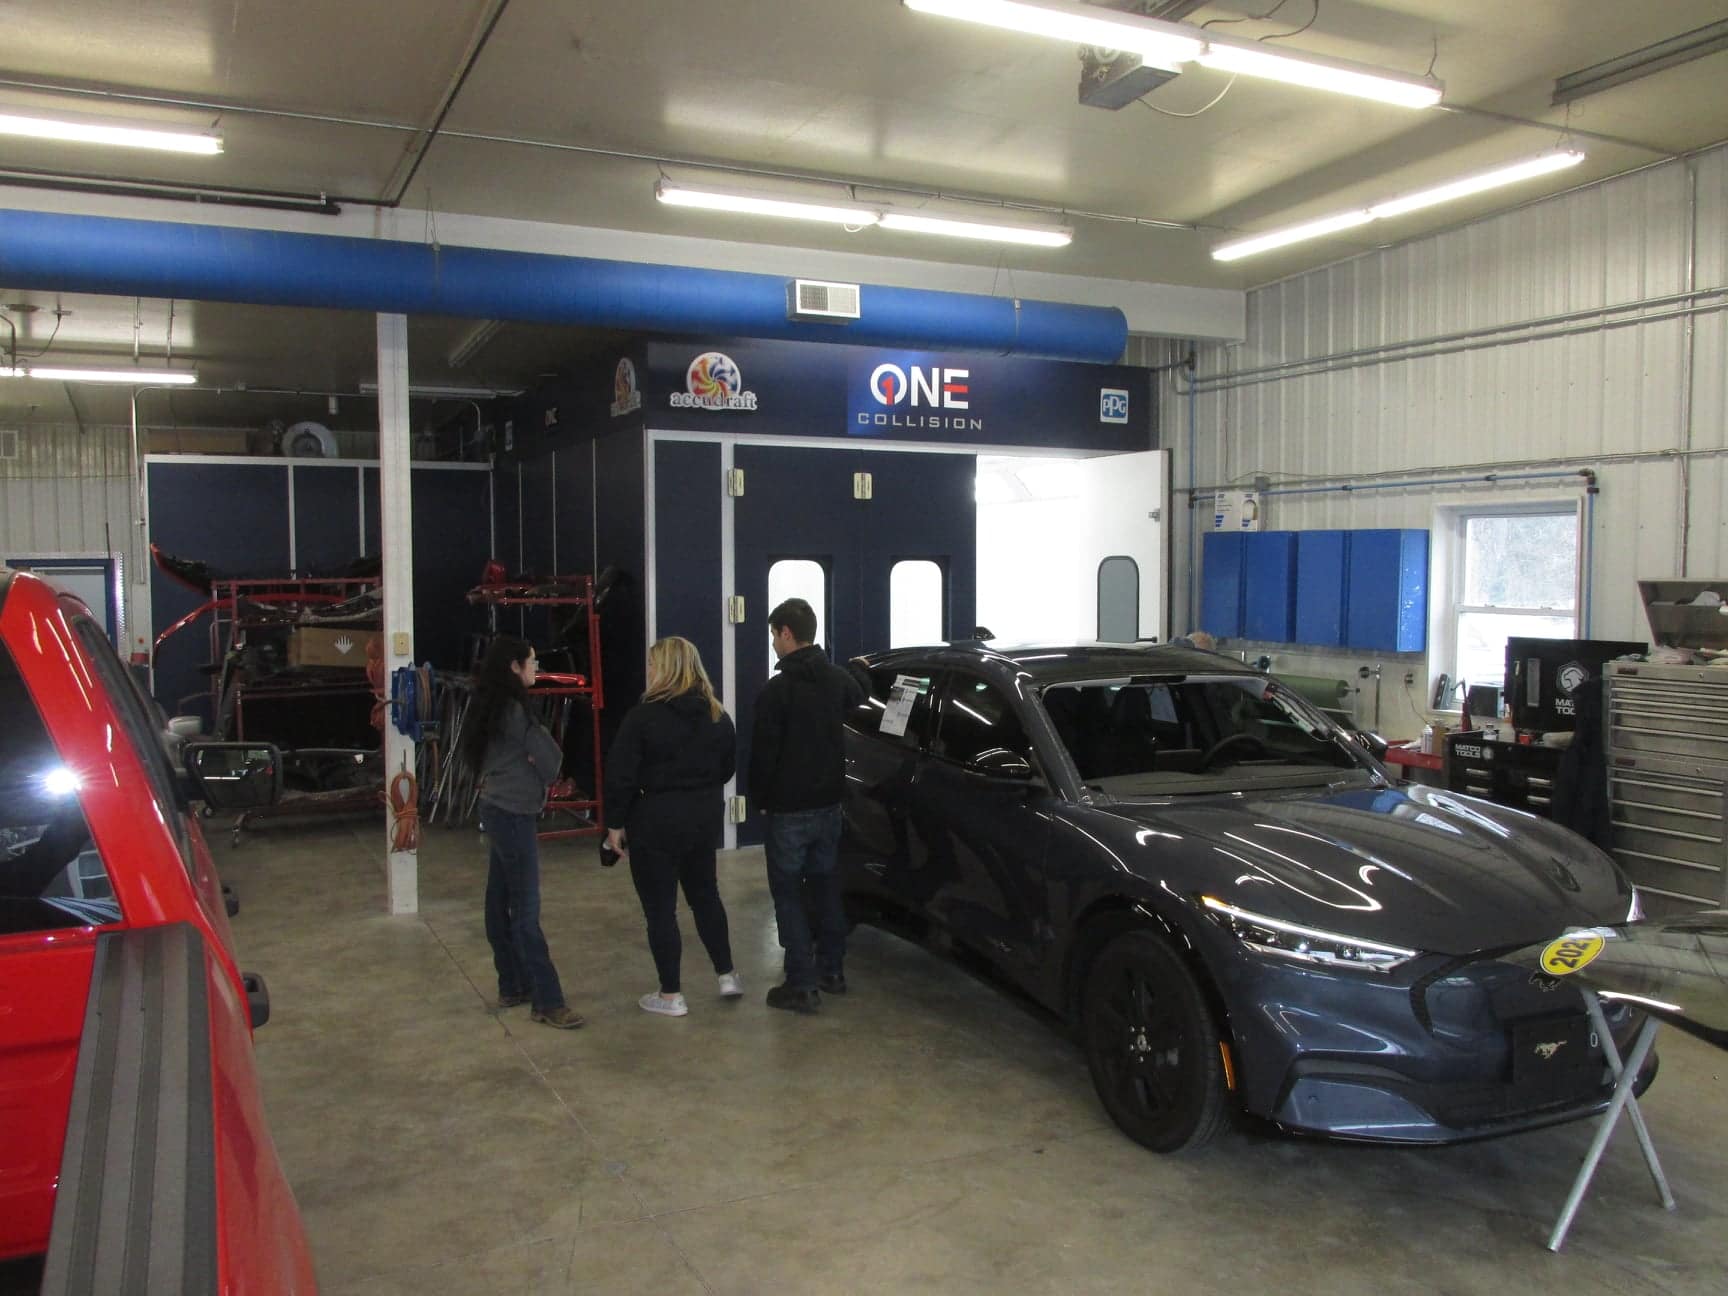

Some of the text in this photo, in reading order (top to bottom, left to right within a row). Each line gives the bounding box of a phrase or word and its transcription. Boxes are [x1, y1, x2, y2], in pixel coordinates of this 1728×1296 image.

[1103, 395, 1127, 416] PPG
[858, 413, 983, 430] COLLISION
[1549, 936, 1594, 968] 202
